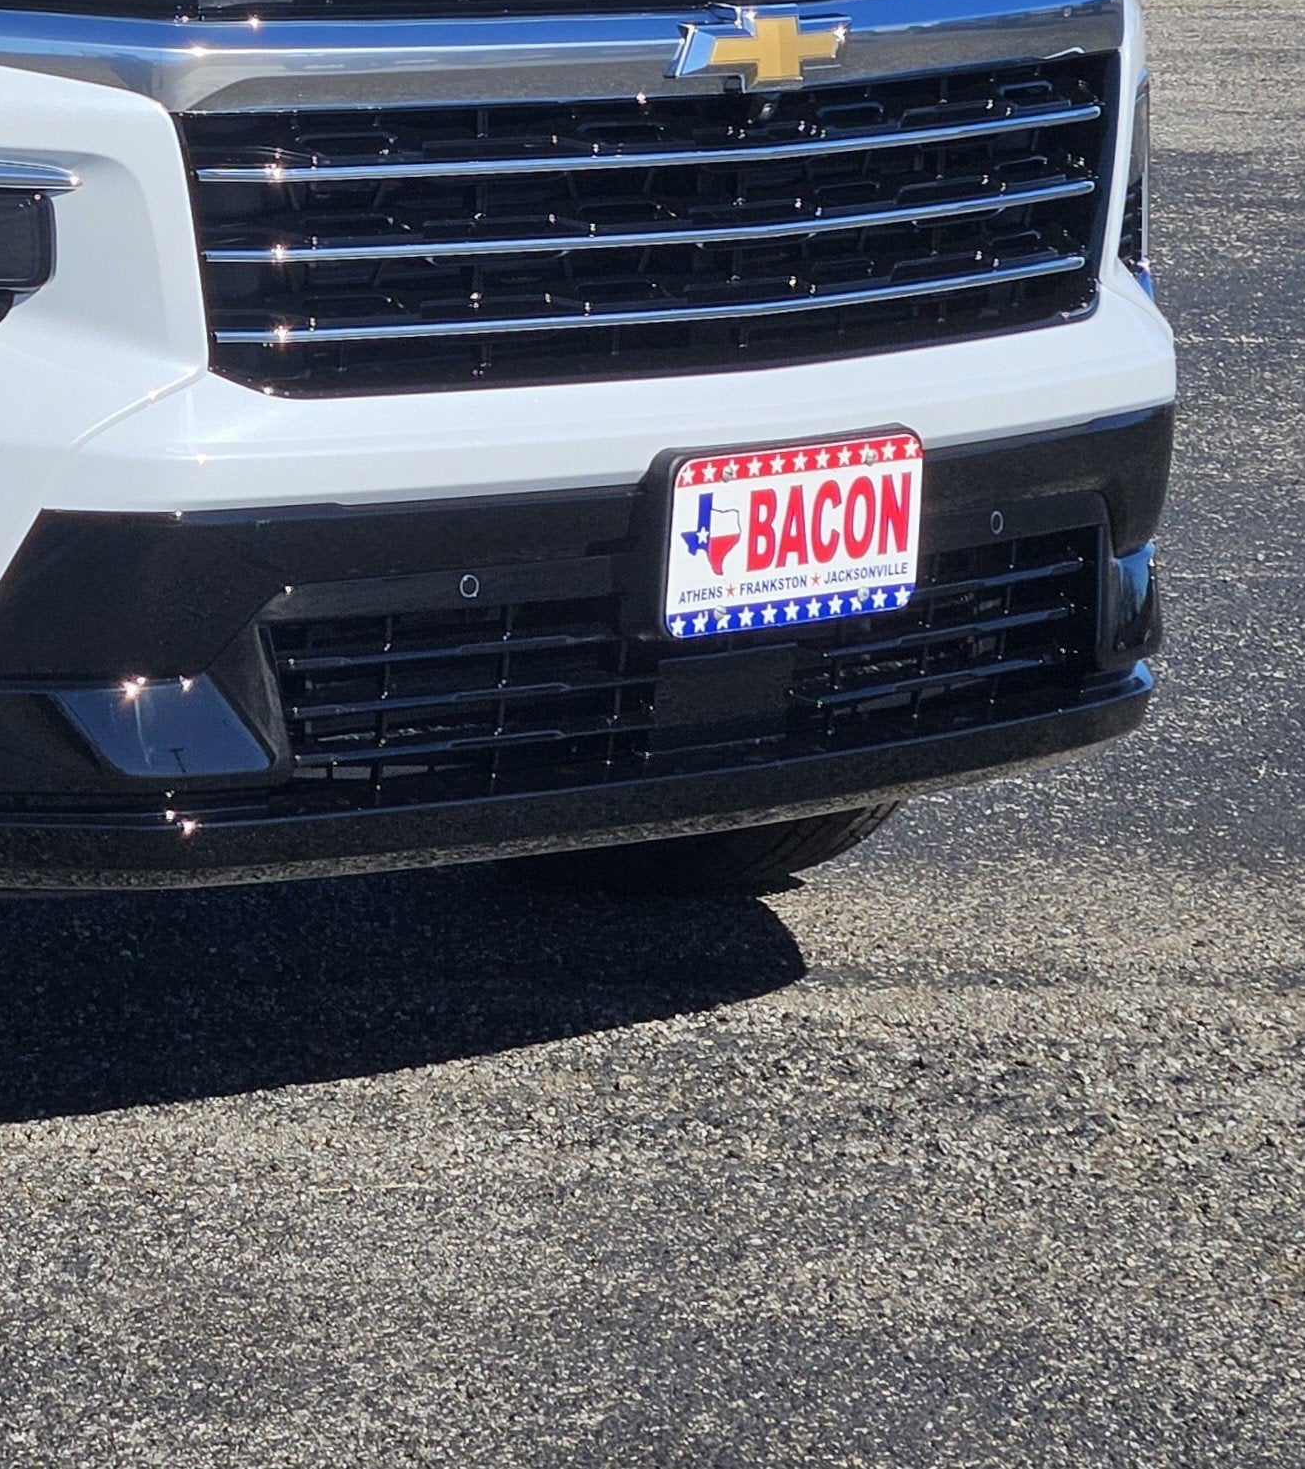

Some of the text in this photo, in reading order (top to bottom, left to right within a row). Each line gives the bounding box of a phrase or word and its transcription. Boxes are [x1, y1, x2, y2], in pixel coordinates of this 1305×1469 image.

[746, 472, 913, 573] BACON
[678, 562, 909, 605] ATHENS FRANKSTON JACKSONVILLE
